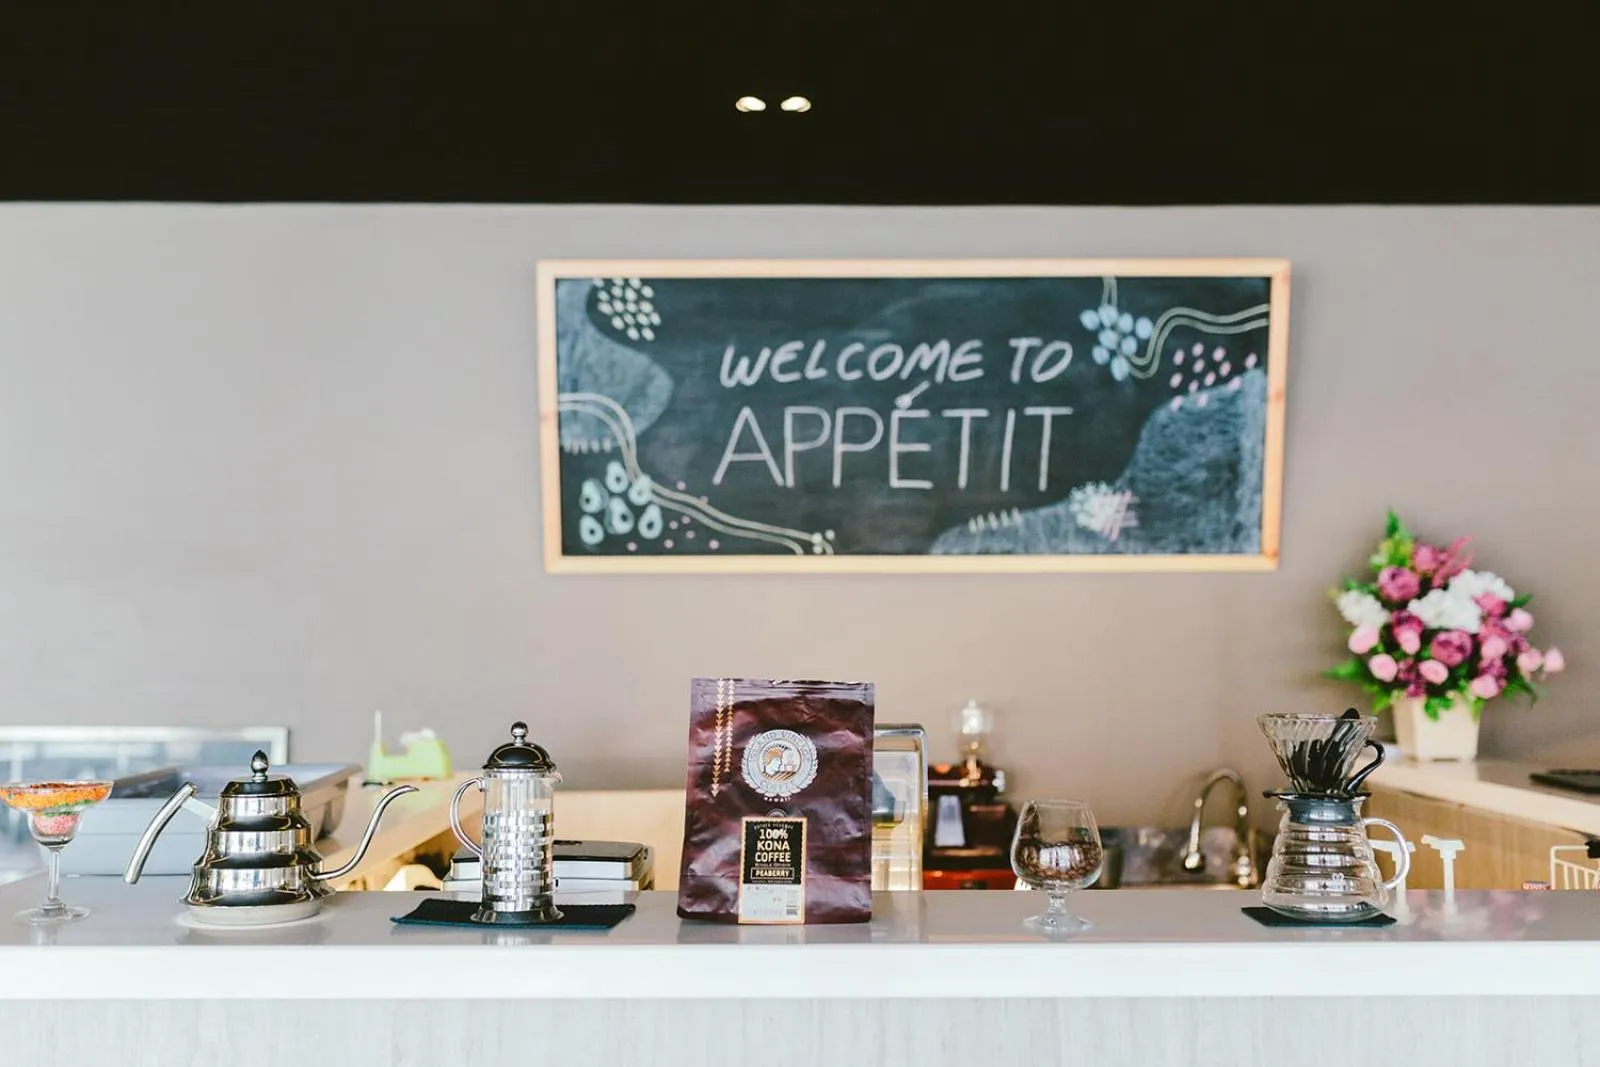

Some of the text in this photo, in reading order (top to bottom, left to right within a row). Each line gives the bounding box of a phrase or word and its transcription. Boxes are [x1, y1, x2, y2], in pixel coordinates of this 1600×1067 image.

[720, 337, 1075, 389] WELCOME TO
[713, 383, 1074, 492] APPÉTIT
[759, 828, 788, 839] 100%
[757, 840, 790, 851] KONA
[755, 852, 791, 863] COFFEE
[755, 869, 790, 877] PEABERRY
